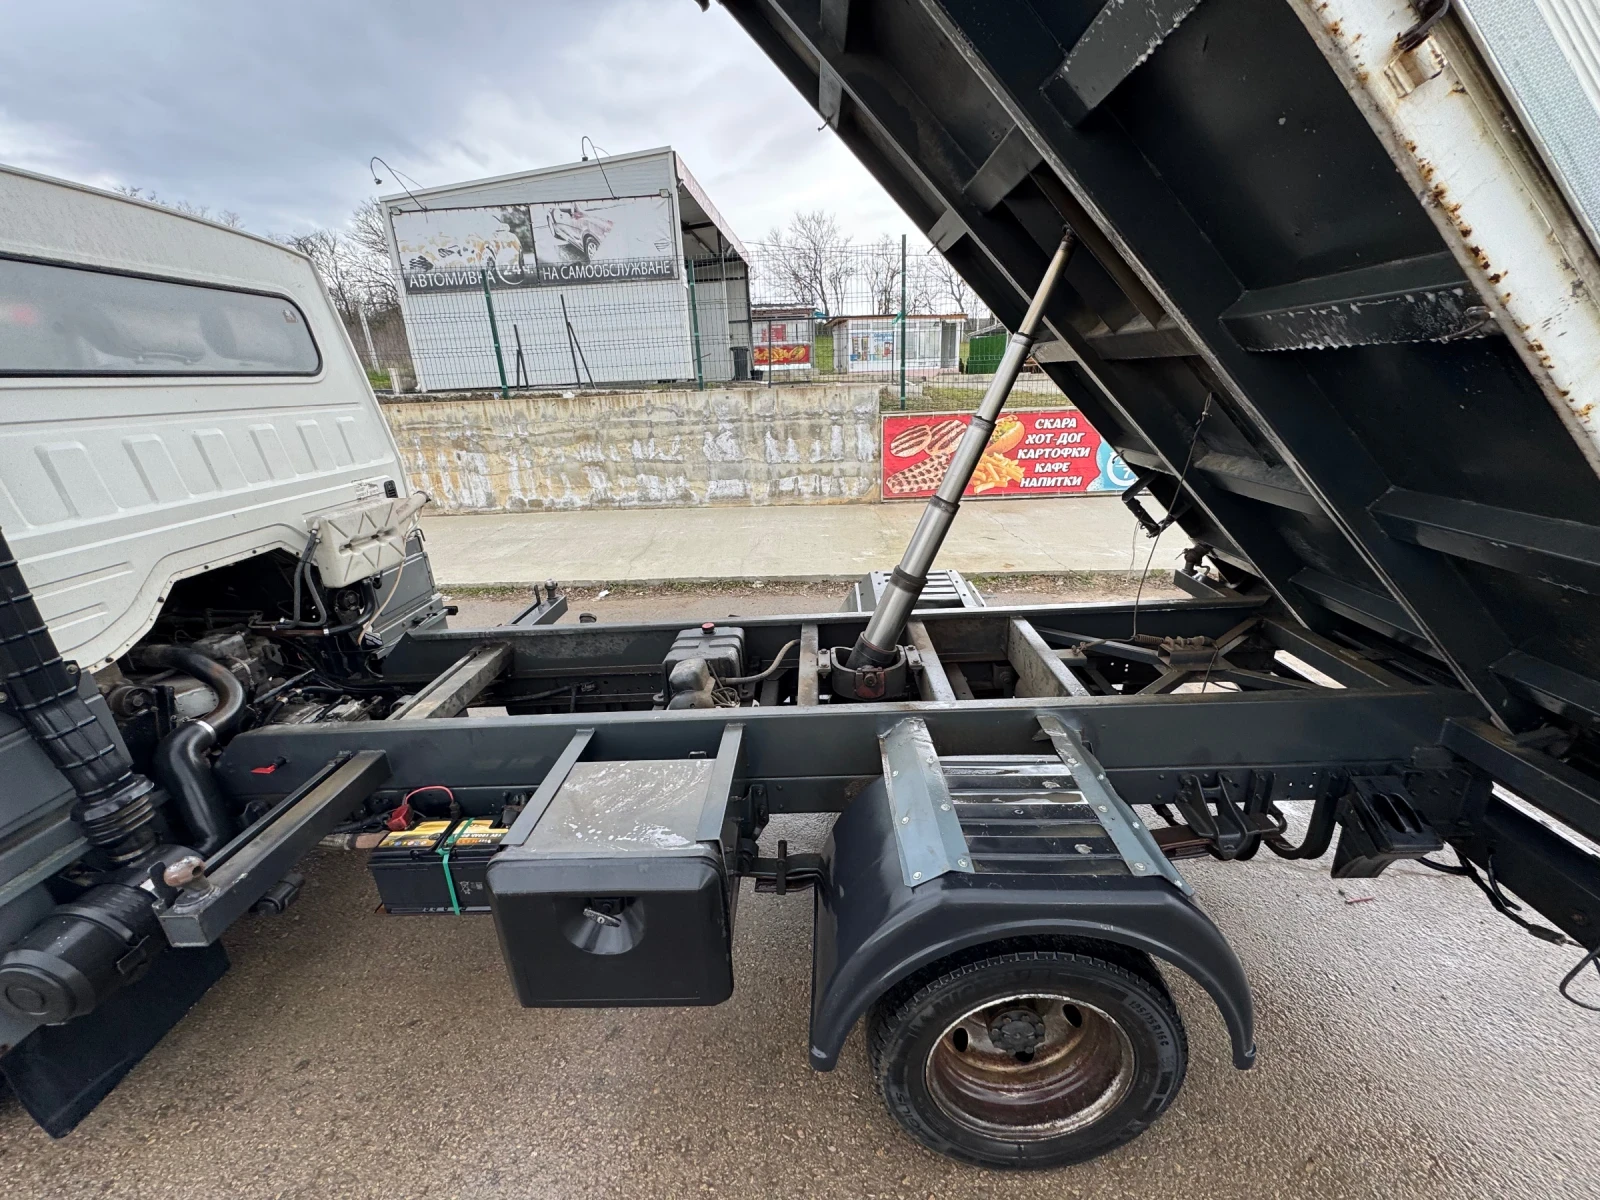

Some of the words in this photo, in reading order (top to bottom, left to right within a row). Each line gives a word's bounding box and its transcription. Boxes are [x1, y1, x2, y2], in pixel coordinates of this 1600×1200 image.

[542, 266, 560, 280] НА
[560, 260, 671, 280] САМООБСЛУЖВАНЕ
[1034, 417, 1077, 429] СКАРА
[1025, 432, 1086, 446] ХОТ-ДОГ
[1017, 447, 1091, 460] КАРТОФКИ
[1034, 462, 1071, 473] КАФЕ
[1019, 476, 1083, 488] НАПИТКИ
